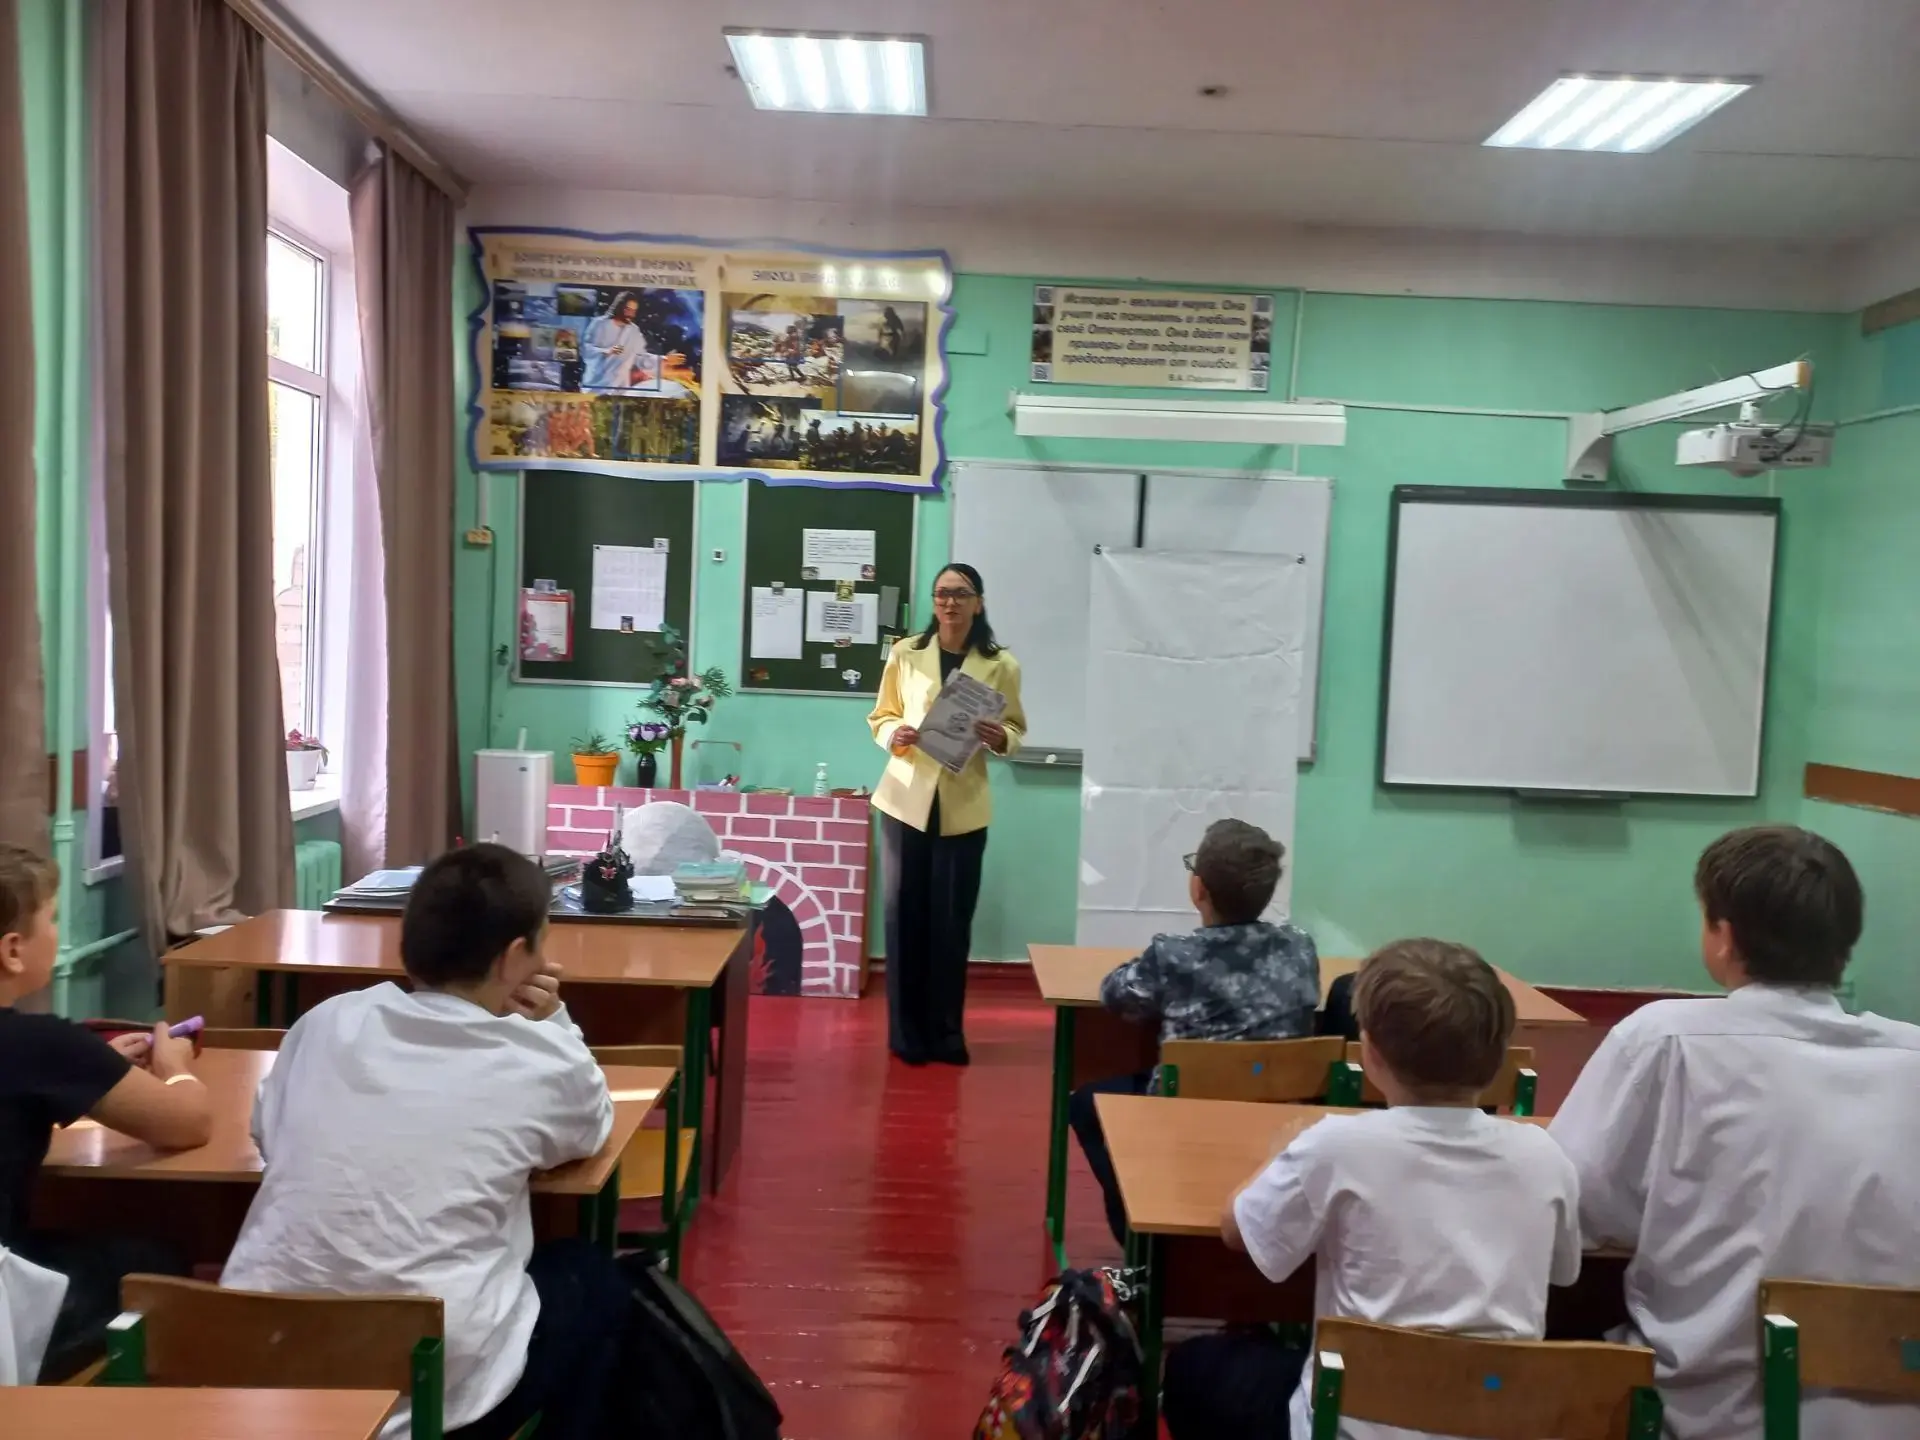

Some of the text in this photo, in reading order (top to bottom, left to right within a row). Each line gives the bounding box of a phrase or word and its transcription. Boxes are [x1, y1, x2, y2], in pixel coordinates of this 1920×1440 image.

[1063, 293, 1120, 306] История
[1222, 299, 1246, 311] Она
[1095, 312, 1118, 321] нас
[1119, 313, 1183, 324] понимать
[1196, 314, 1247, 327] любить
[1165, 326, 1189, 338] Она
[1068, 340, 1123, 352] примеры
[1126, 339, 1149, 351] для
[1151, 341, 1226, 355] подражания
[1169, 359, 1188, 367] от
